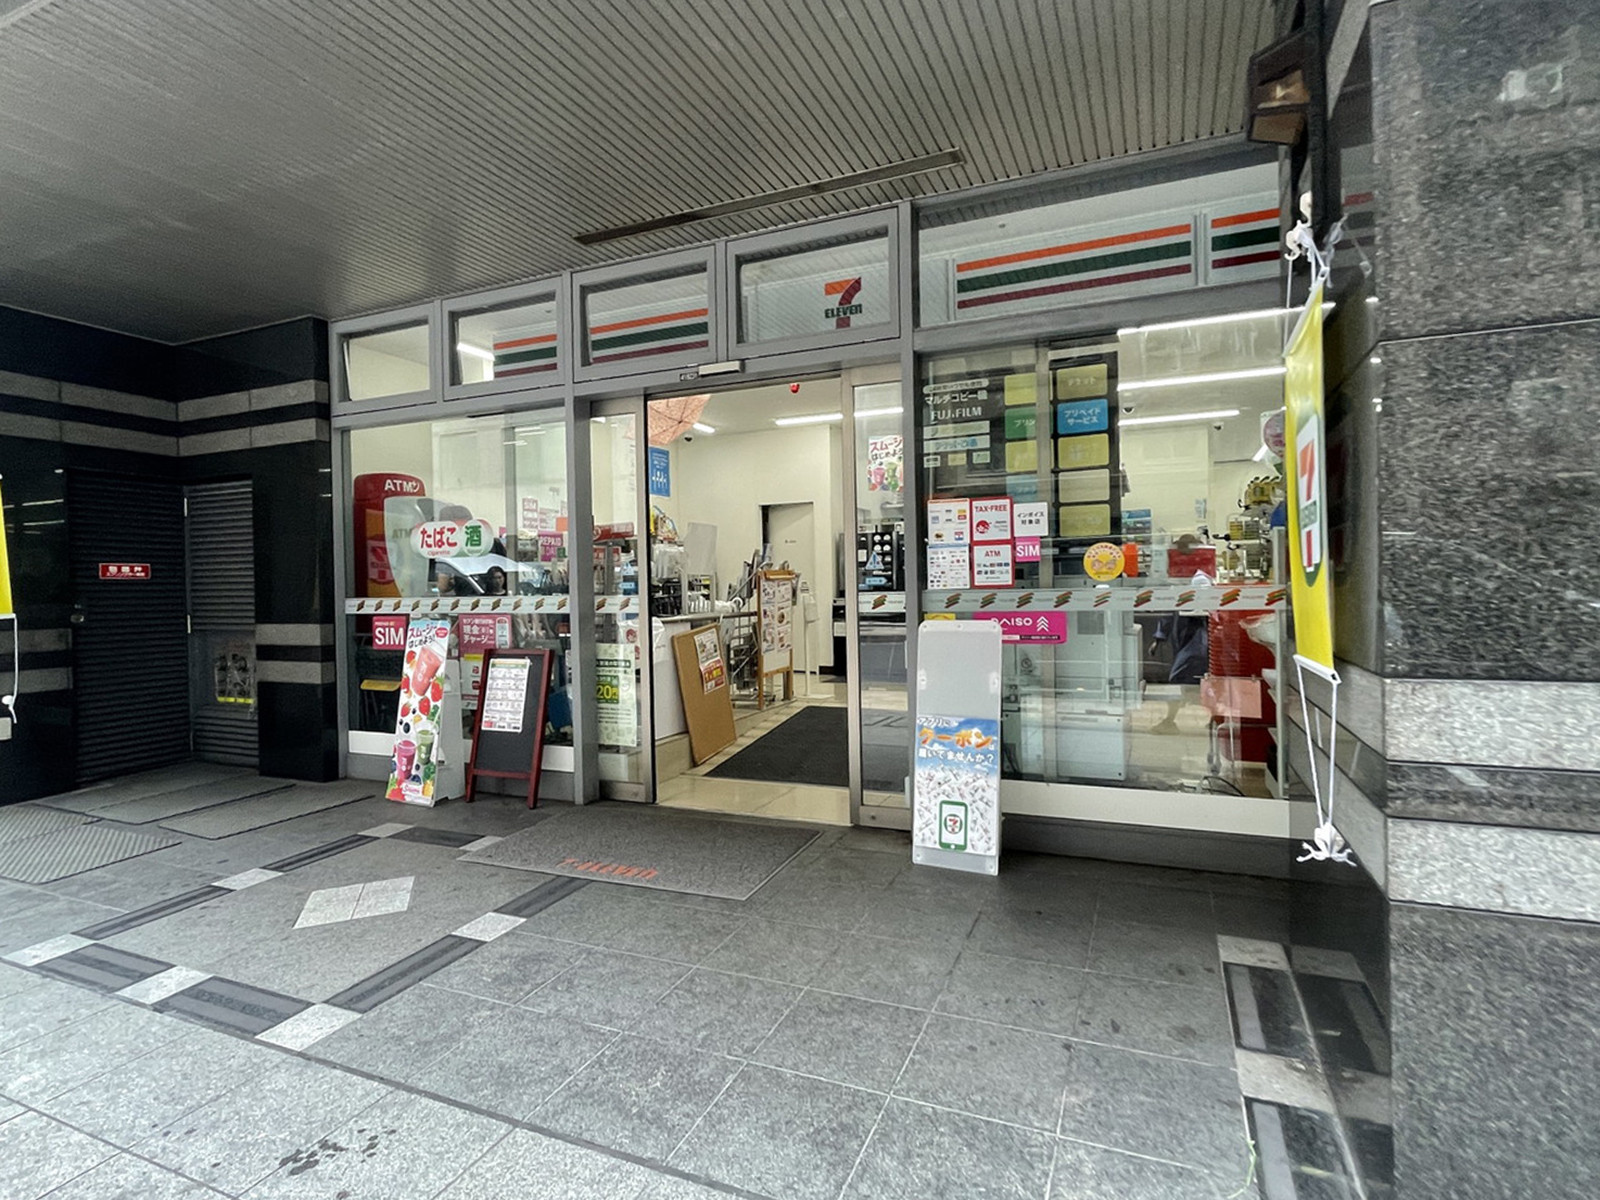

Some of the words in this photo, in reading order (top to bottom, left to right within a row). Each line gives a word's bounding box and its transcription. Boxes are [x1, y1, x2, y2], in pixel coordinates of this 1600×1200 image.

[384, 479, 414, 492] ATM
[975, 504, 1008, 512] TAX-FREE
[420, 526, 457, 549] たばこ
[465, 525, 481, 547] 酒
[984, 550, 1002, 558] ATM
[1016, 545, 1040, 557] SIM
[375, 627, 404, 646] SIM
